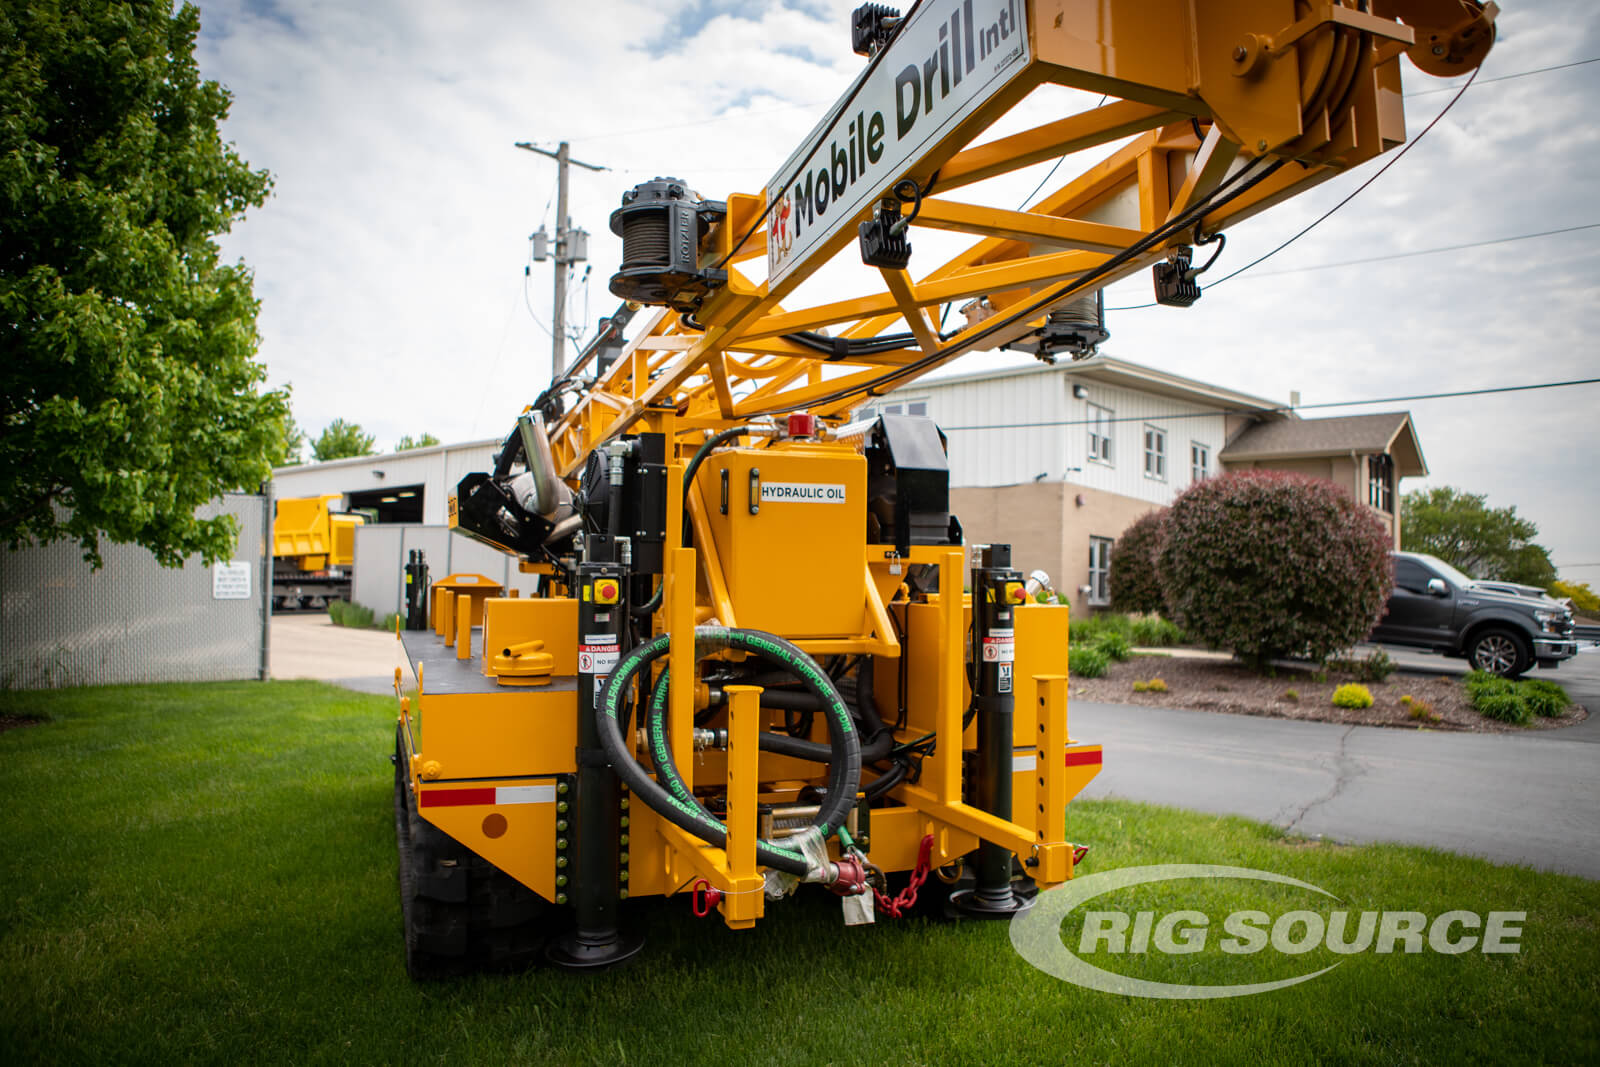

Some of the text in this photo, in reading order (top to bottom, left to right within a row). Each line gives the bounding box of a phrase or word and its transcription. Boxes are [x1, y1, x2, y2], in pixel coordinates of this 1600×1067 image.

[795, 0, 1016, 238] Mobile Drill Intl
[761, 486, 845, 499] HYDRAULIC OIL
[590, 645, 619, 653] DANGER
[606, 655, 643, 712] ALFAGOMMA
[653, 669, 671, 711] PURPO
[746, 634, 793, 663] GENERAL
[791, 658, 834, 698] PURPOSE
[832, 702, 853, 733] EPDM
[654, 711, 669, 764] GENERAL
[666, 794, 699, 820] EPDM
